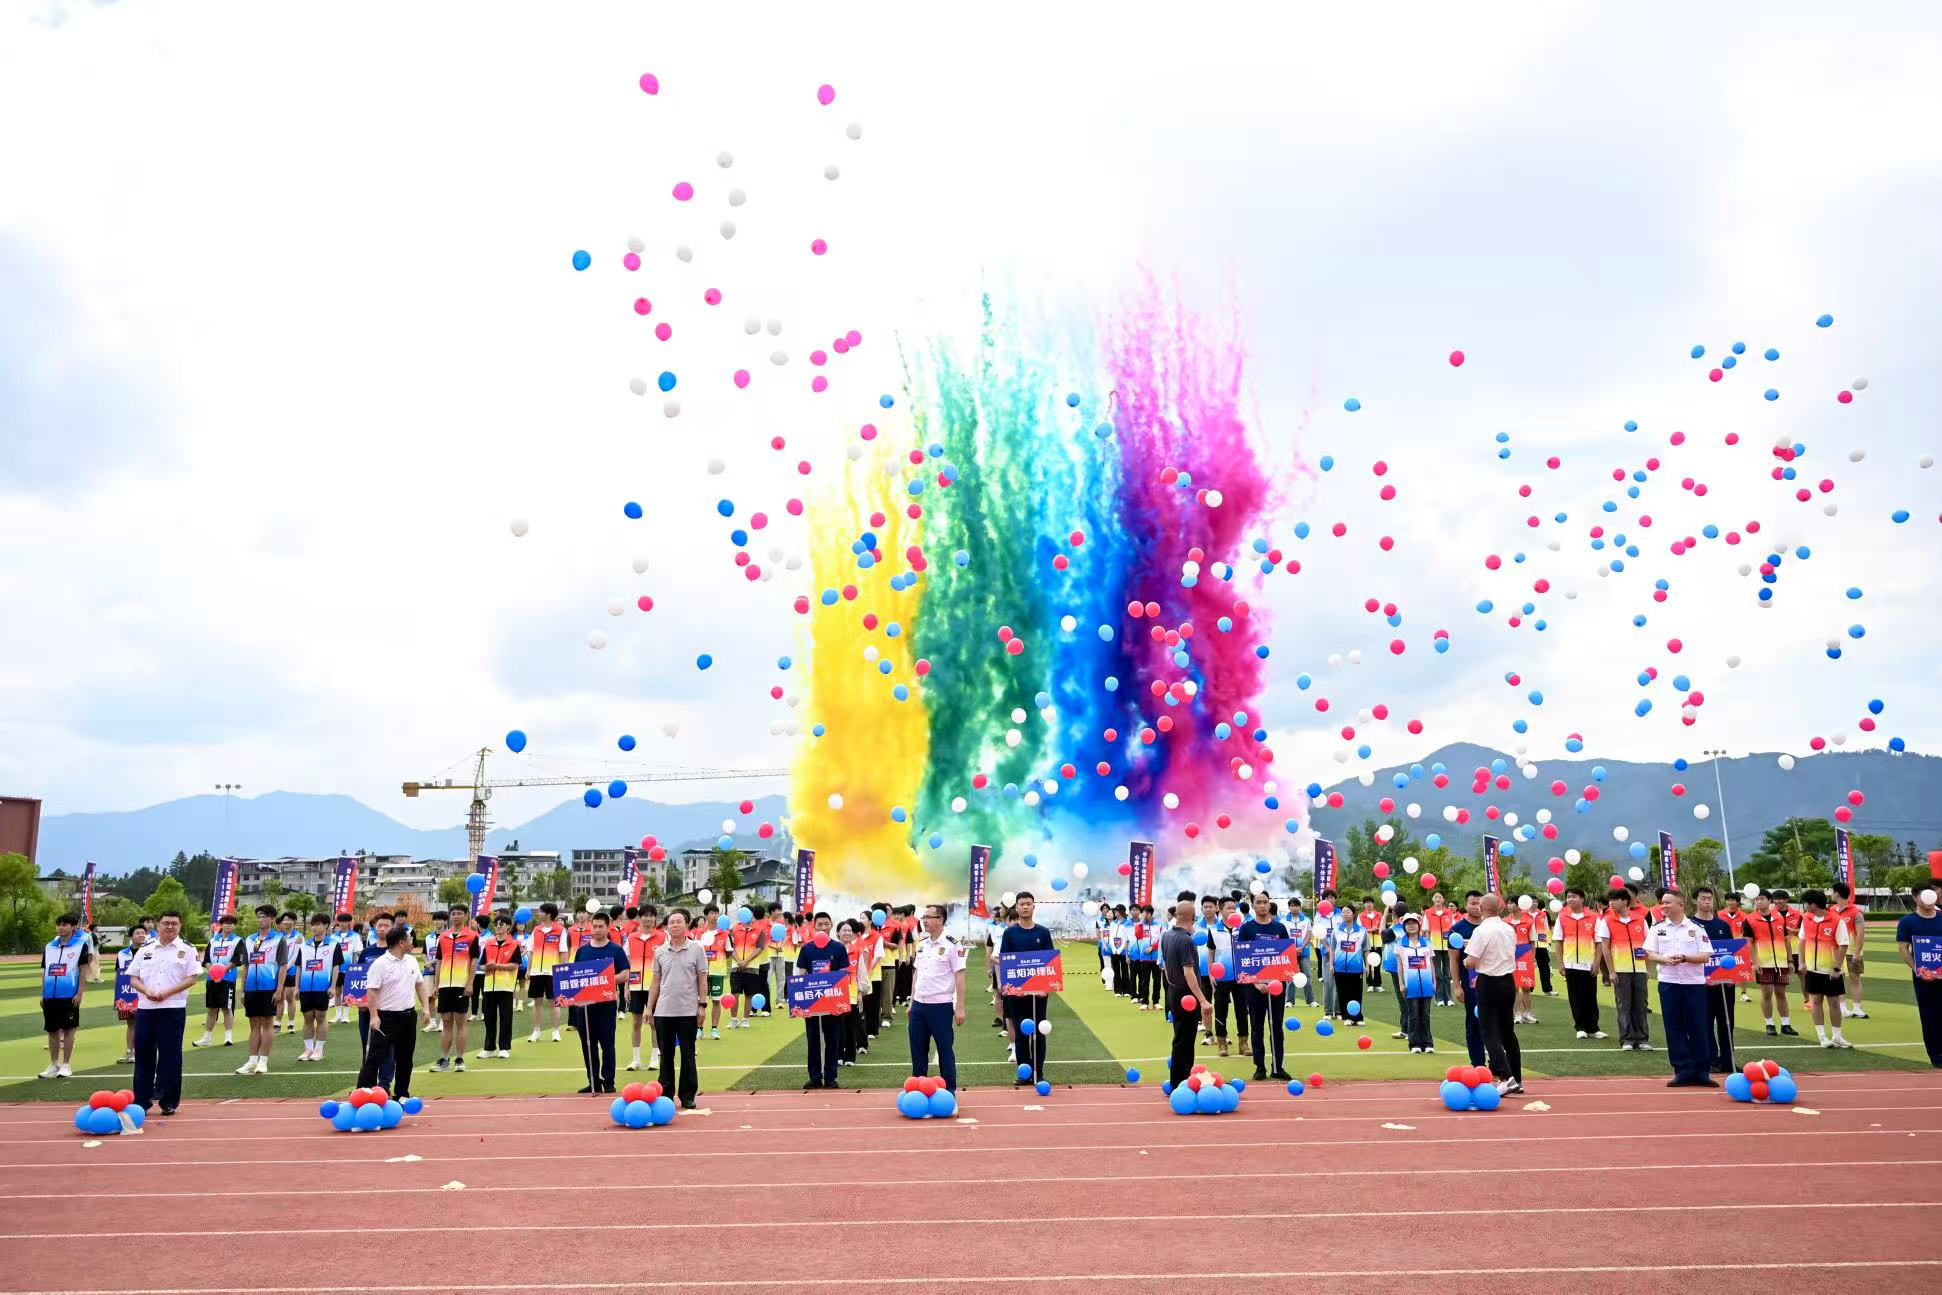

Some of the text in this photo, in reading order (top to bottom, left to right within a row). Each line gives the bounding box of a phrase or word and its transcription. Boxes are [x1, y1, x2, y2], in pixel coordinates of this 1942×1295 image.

[1241, 955, 1291, 968] 逆行者战队
[1006, 966, 1057, 979] 蓝焰冲锋队
[559, 975, 609, 990] 雷霆救援队
[794, 987, 844, 1001] 临危不惧队
